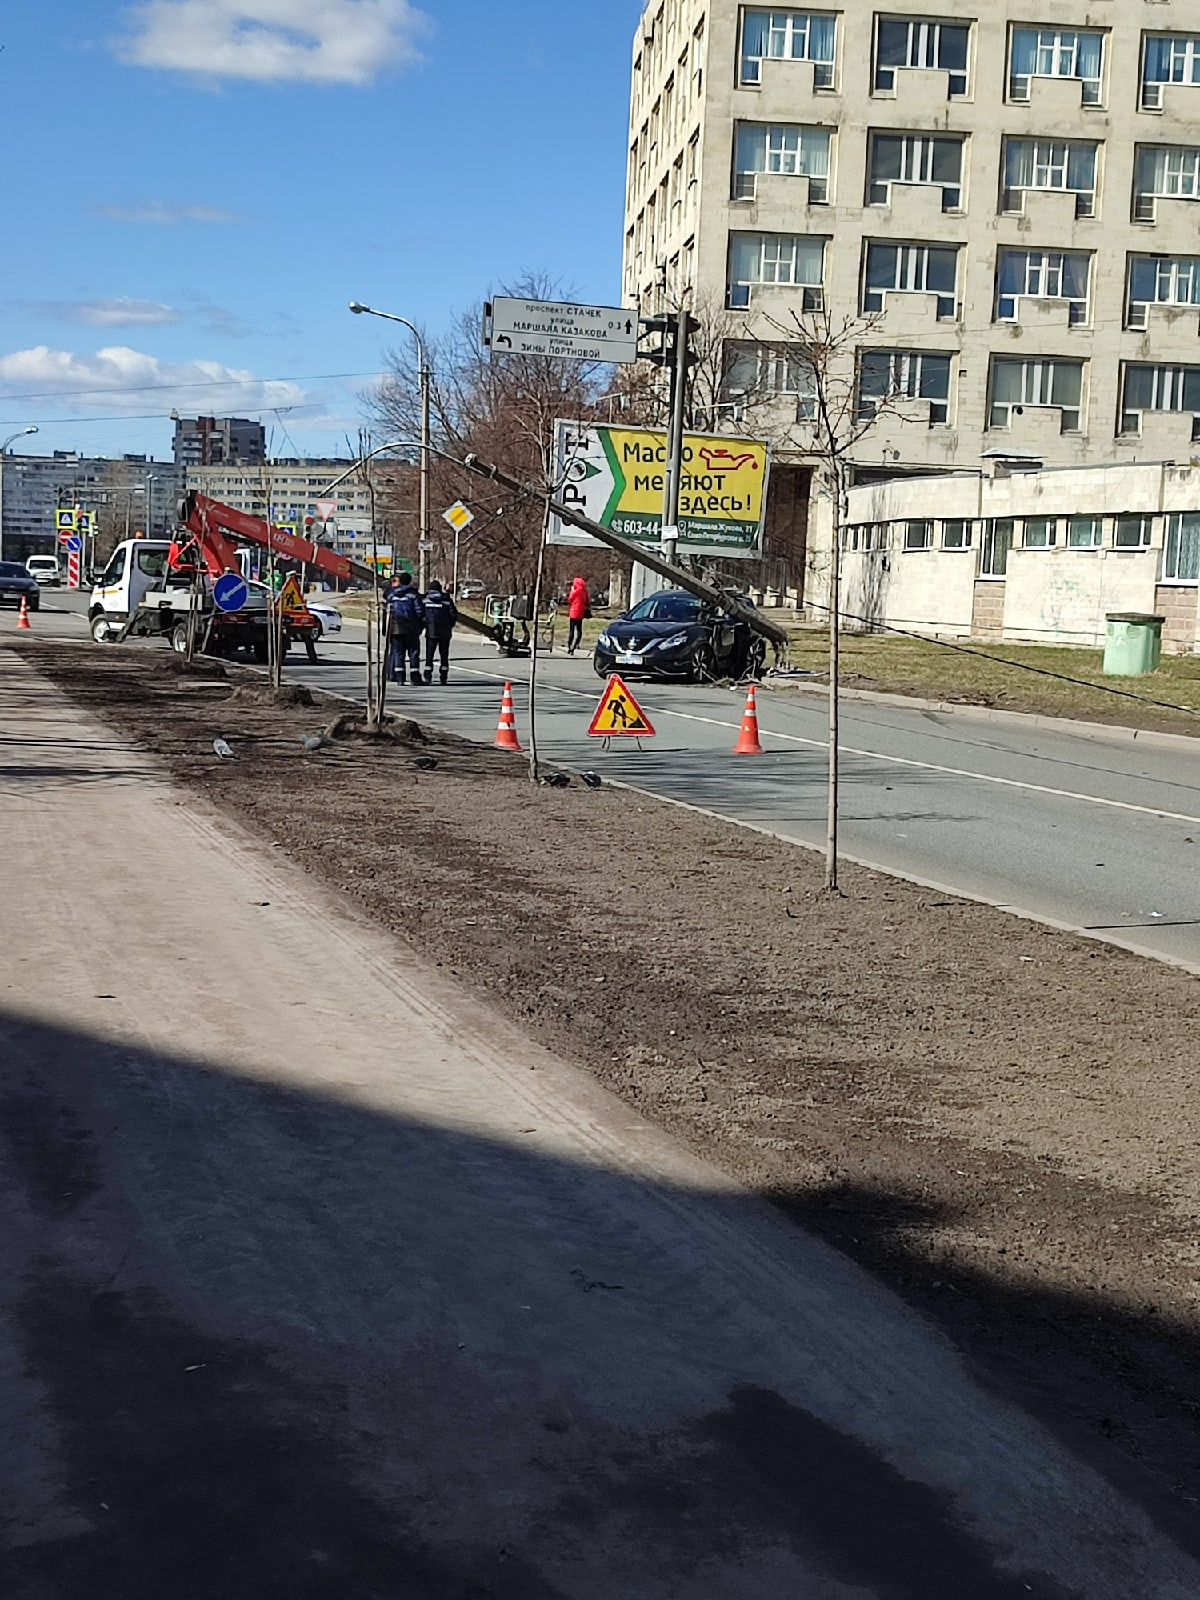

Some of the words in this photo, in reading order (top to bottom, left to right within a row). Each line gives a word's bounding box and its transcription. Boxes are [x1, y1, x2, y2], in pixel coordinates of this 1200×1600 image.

[525, 304, 564, 315] проспект
[566, 307, 602, 318] СТАЧЕК
[513, 321, 559, 334] МАРШАЛА
[561, 326, 607, 338] КАЗАКОВА
[549, 316, 575, 326] улица
[520, 342, 546, 353] ЗИНЫ
[548, 345, 601, 359] ПОРТНОВОЙ
[549, 337, 574, 347] улица
[623, 441, 694, 463] Масо
[634, 473, 726, 492] меяют
[680, 493, 752, 515] здесь!
